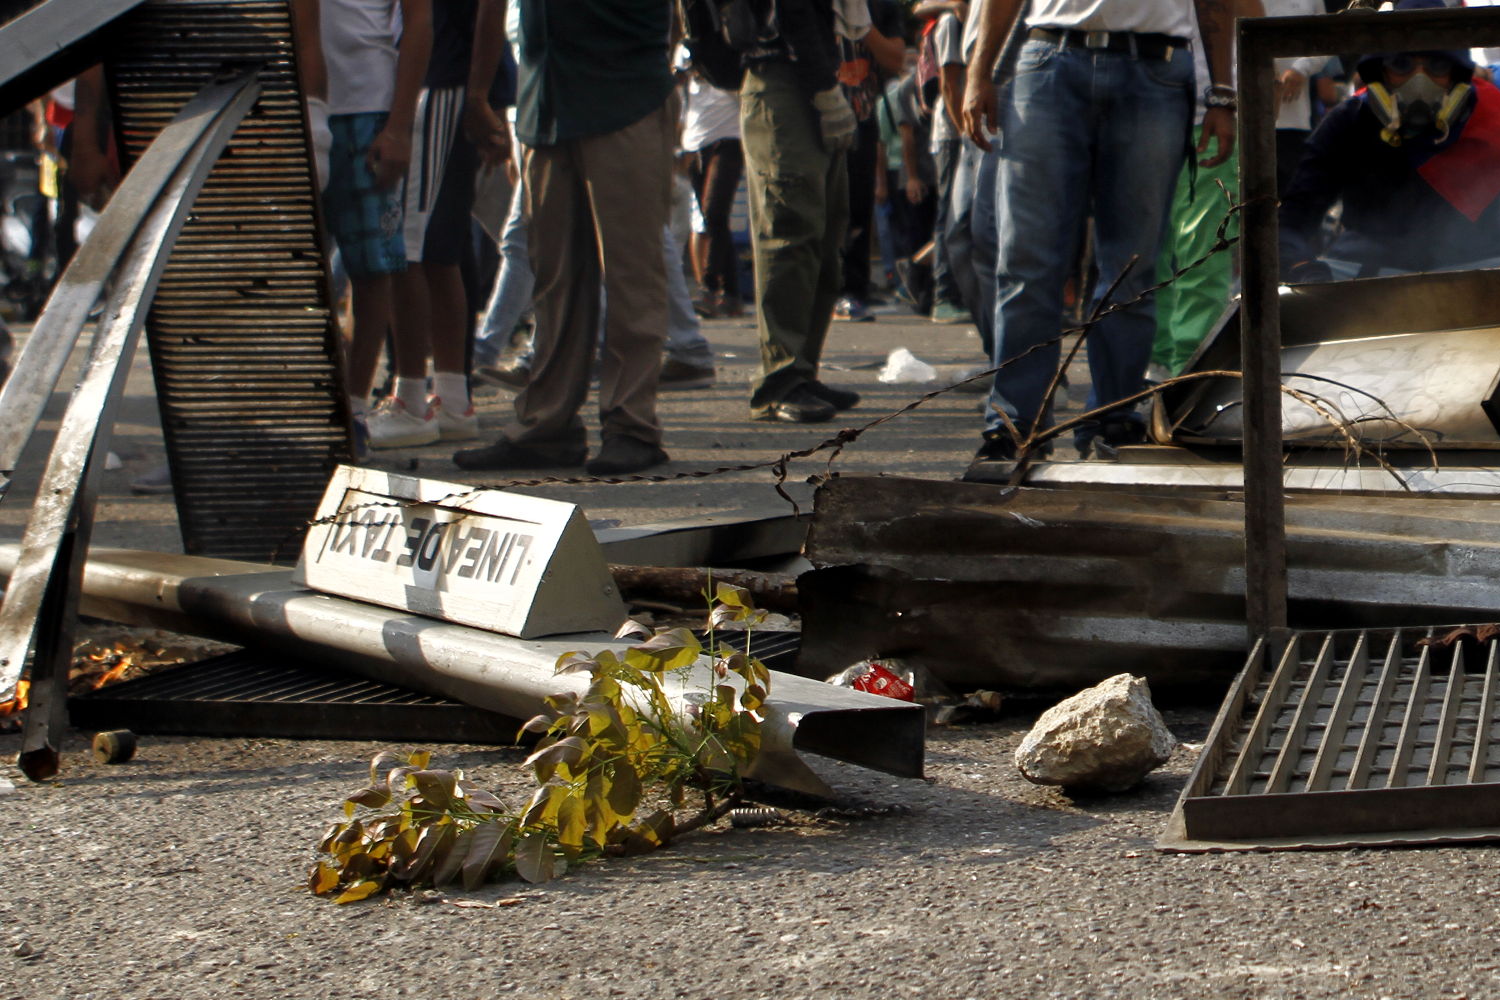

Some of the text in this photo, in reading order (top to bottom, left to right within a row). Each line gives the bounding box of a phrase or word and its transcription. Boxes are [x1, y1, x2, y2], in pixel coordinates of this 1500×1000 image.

[329, 505, 535, 586] LINEA DE TAXI
